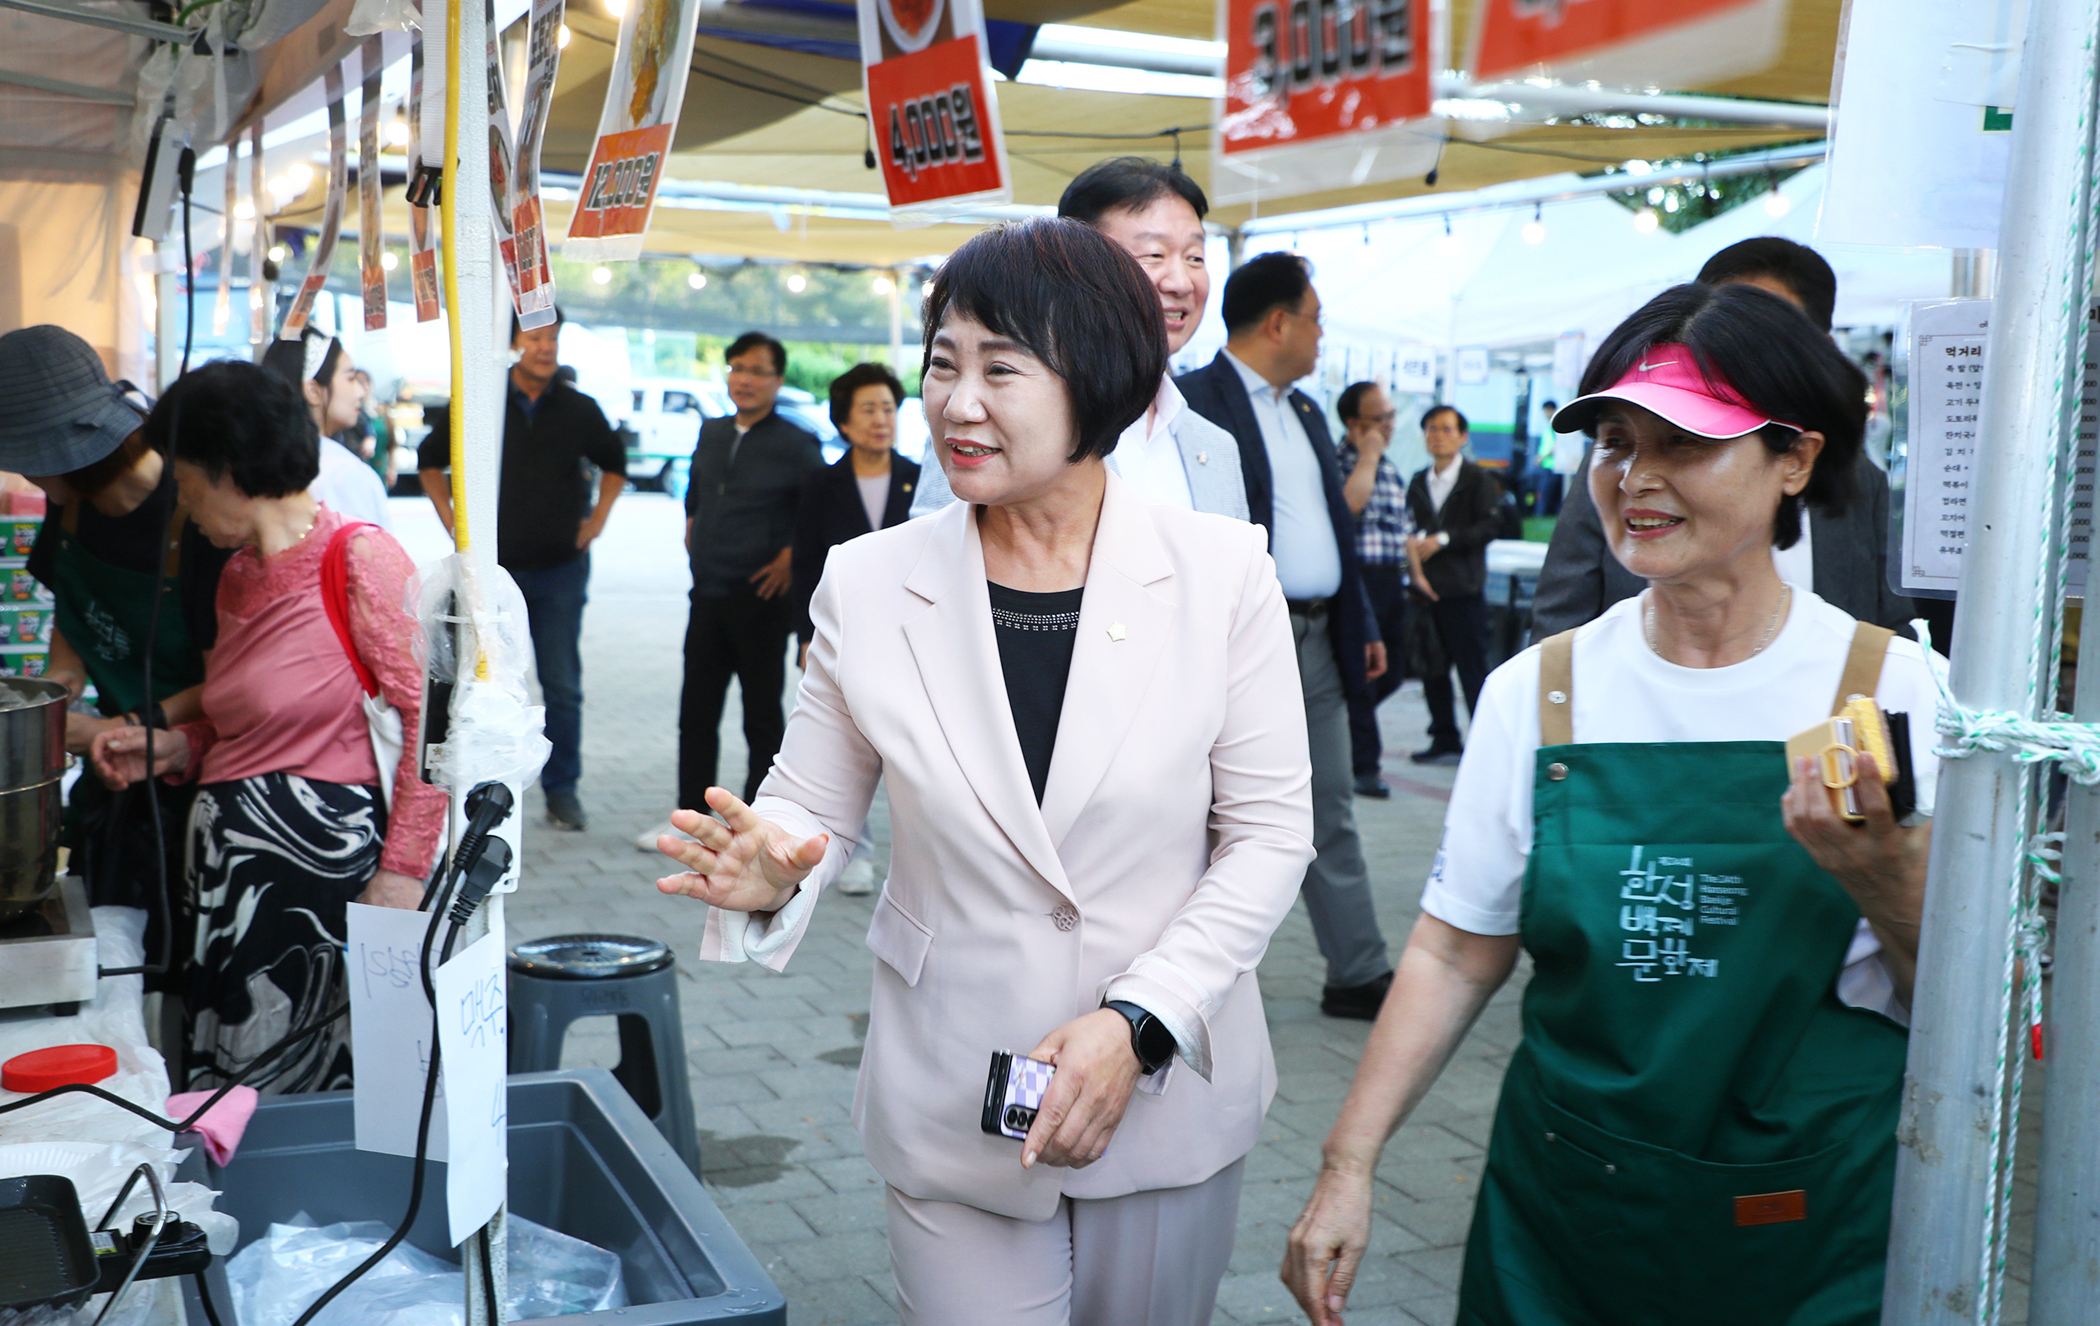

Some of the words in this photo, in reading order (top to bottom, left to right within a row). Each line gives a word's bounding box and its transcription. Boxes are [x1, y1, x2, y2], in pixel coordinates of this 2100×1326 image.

[889, 81, 985, 183] 4,000원
[584, 151, 660, 218] 12,000원
[1945, 346, 1981, 357] 먹거리
[1943, 464, 1961, 472] 순대
[1619, 845, 1695, 911] 한성
[1619, 904, 1694, 937] 백제
[1614, 937, 1719, 982] 문화제
